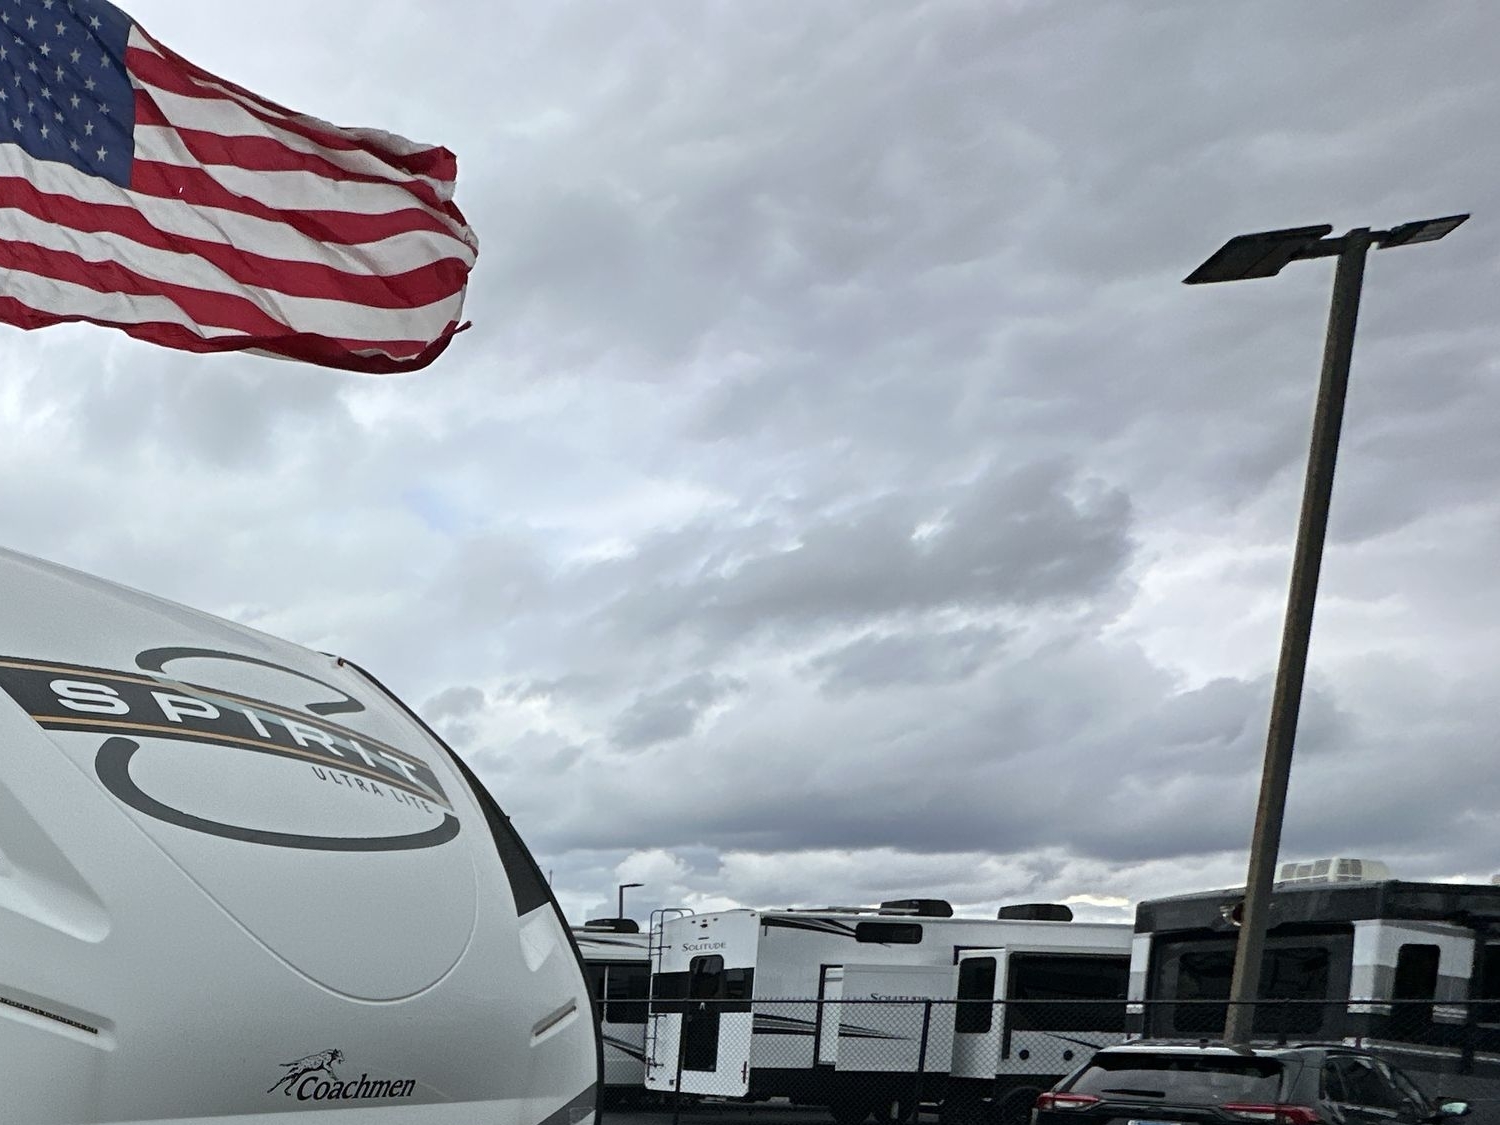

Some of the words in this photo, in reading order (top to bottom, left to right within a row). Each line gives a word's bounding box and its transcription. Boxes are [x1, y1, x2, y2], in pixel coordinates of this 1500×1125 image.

[49, 679, 419, 784] SPIRIT
[312, 766, 382, 797] ULTRA
[390, 788, 433, 815] LITE
[297, 1073, 416, 1101] Coachmen
